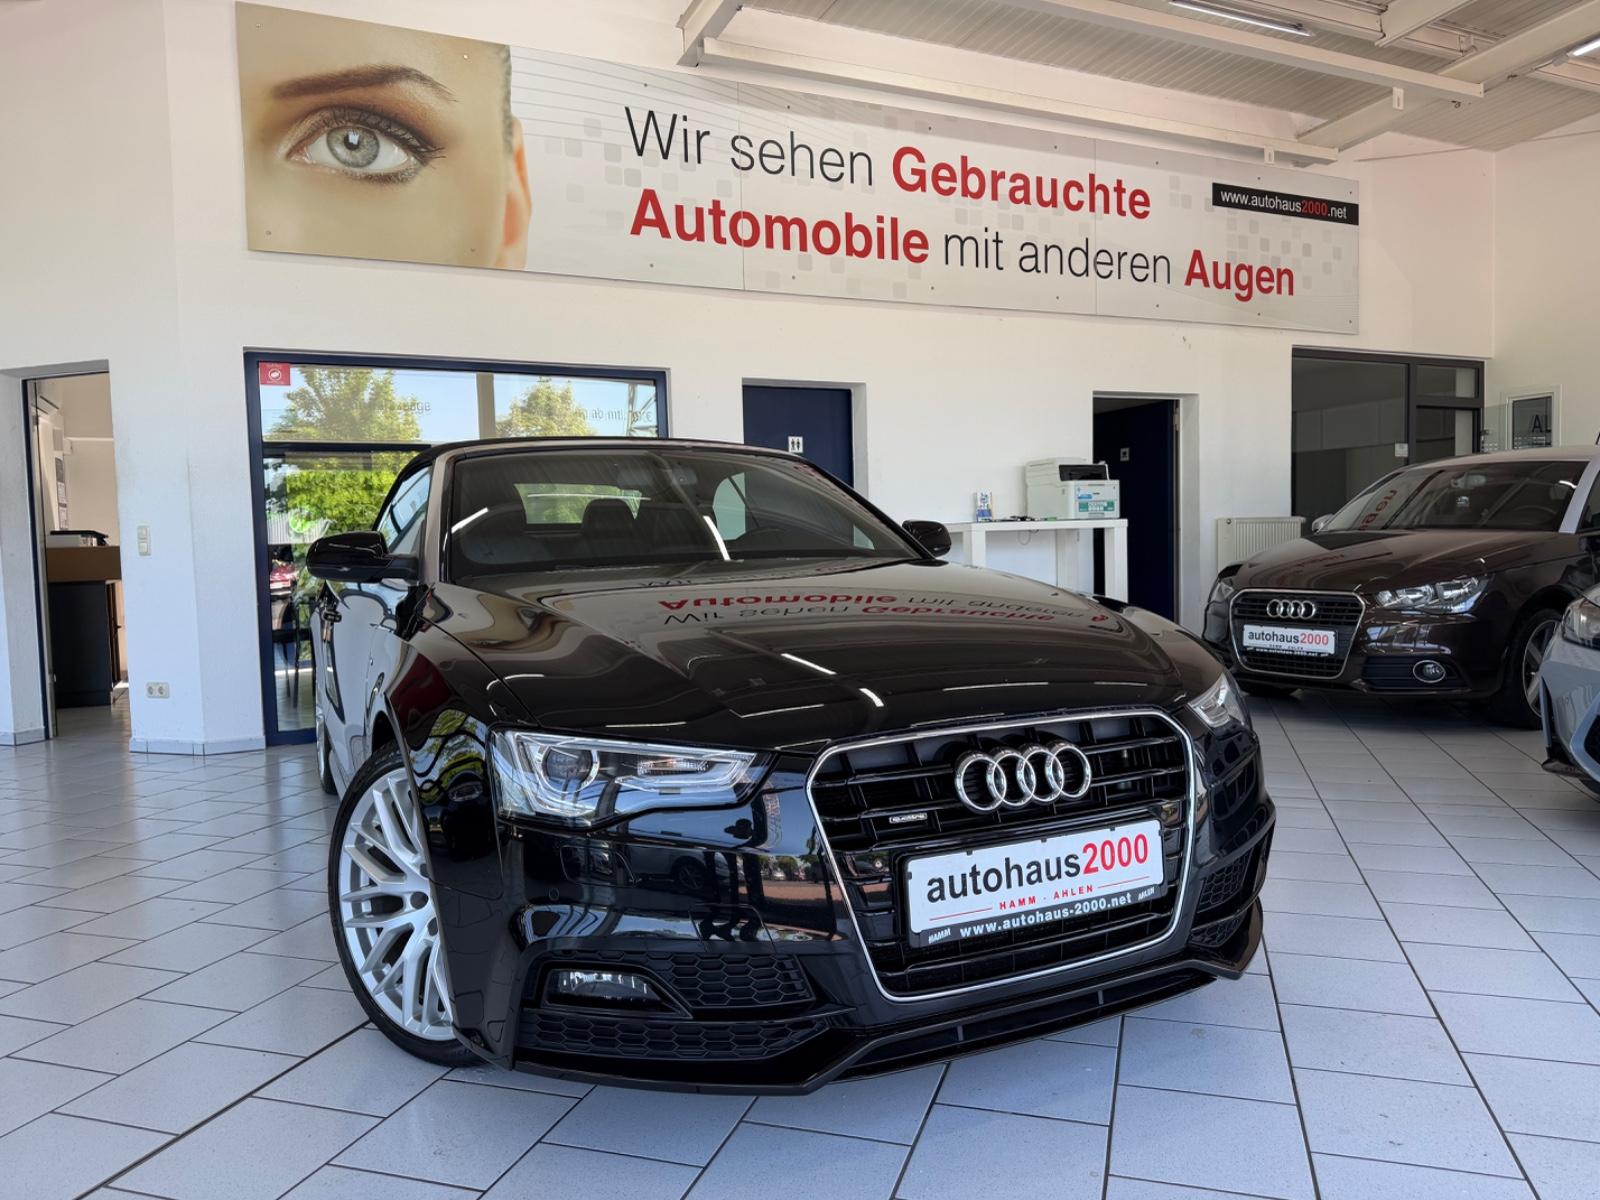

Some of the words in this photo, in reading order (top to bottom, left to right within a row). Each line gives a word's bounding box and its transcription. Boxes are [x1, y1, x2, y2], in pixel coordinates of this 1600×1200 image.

[625, 106, 710, 164] Wir
[731, 131, 872, 185] sehen
[892, 146, 1151, 219] Gebrauchte
[1220, 189, 1347, 219] www.autohaus2000.net
[630, 188, 929, 263] Automobile
[944, 227, 1003, 270] mit
[1018, 237, 1170, 284] anderen
[1184, 249, 1294, 302] Augen
[1248, 631, 1329, 645] autohaus2000
[927, 833, 1149, 903] autohaus2000
[960, 893, 1132, 938] www.autohaus-2000.net
[999, 896, 1036, 910] HAMM
[1053, 884, 1094, 900] AHLEN
